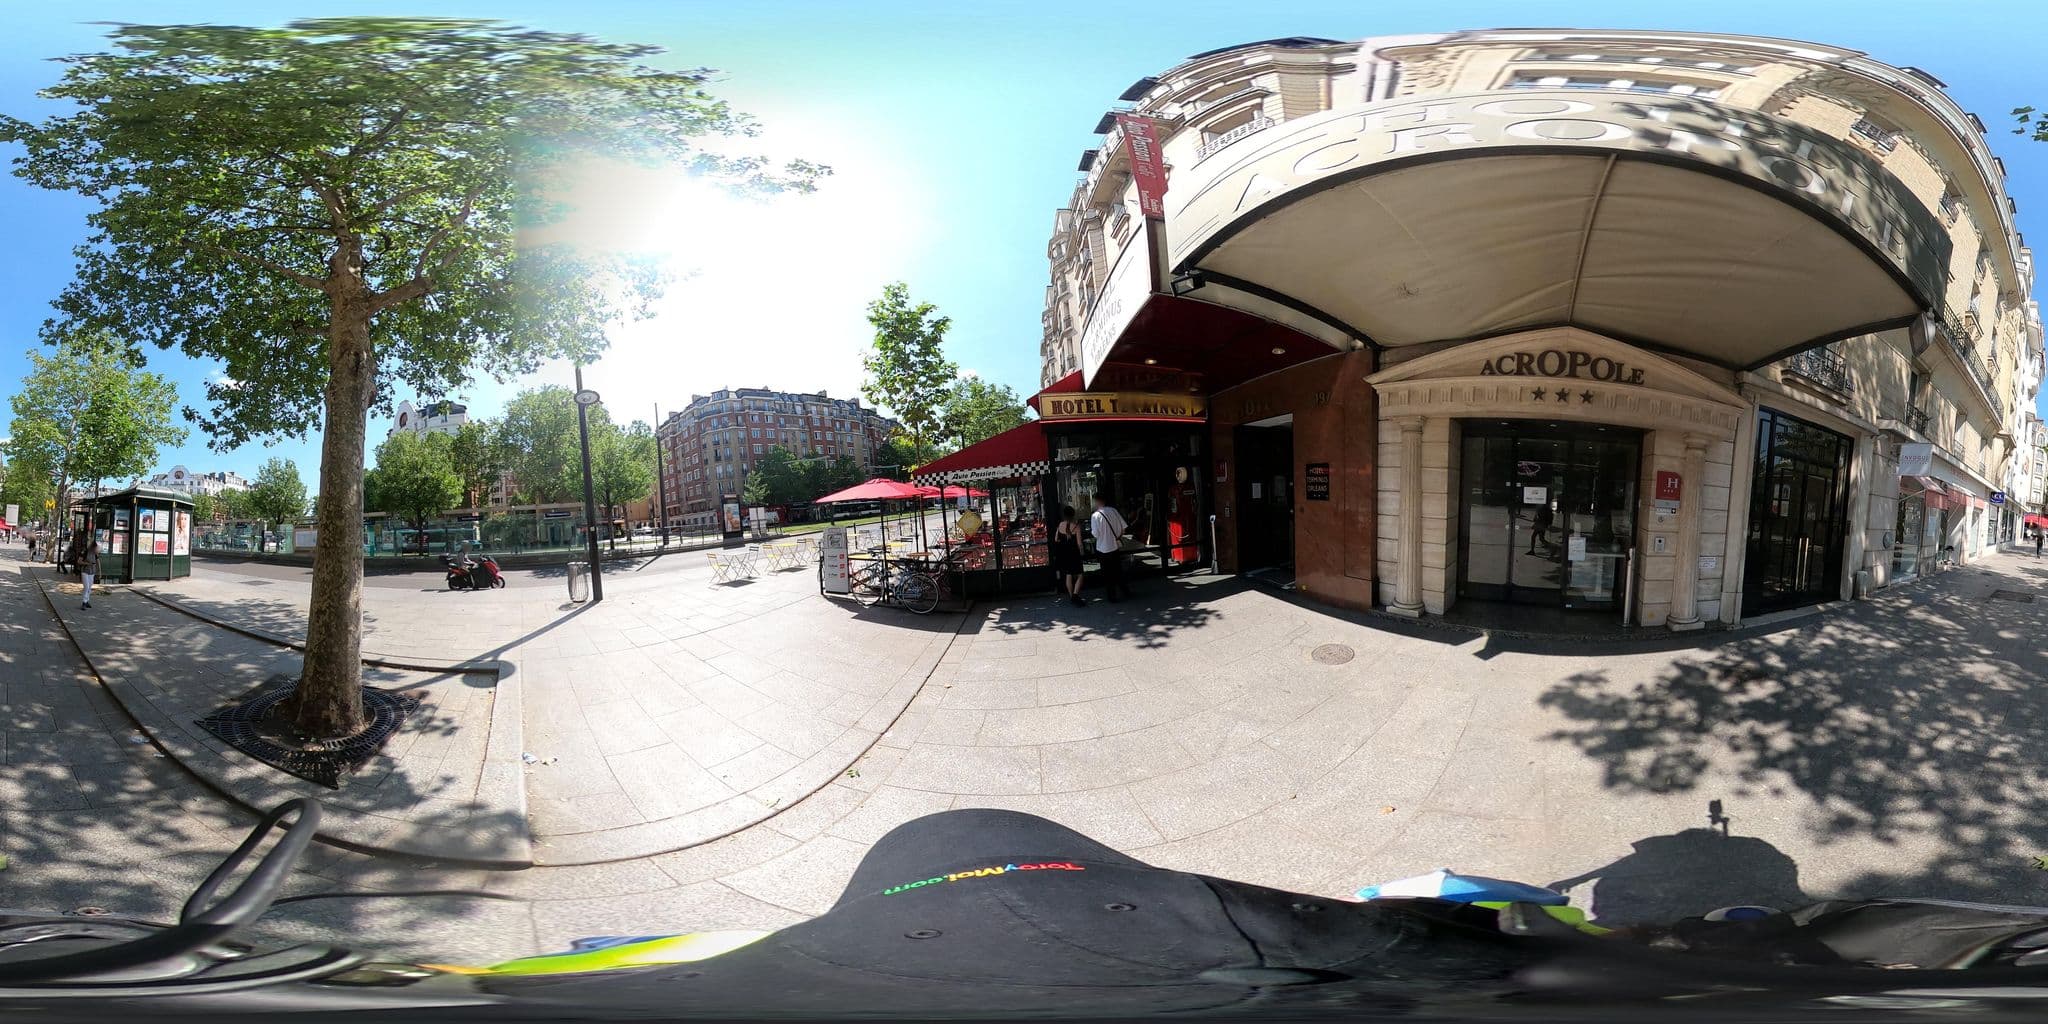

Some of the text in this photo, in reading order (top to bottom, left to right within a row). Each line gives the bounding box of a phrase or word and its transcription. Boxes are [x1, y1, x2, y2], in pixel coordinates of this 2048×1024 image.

[1233, 117, 1906, 264] ACROPOLE
[1480, 350, 1645, 385] ACROPOLE
[1051, 398, 1105, 415] HOTEL
[970, 470, 996, 479] Passion
[1667, 478, 1678, 488] H
